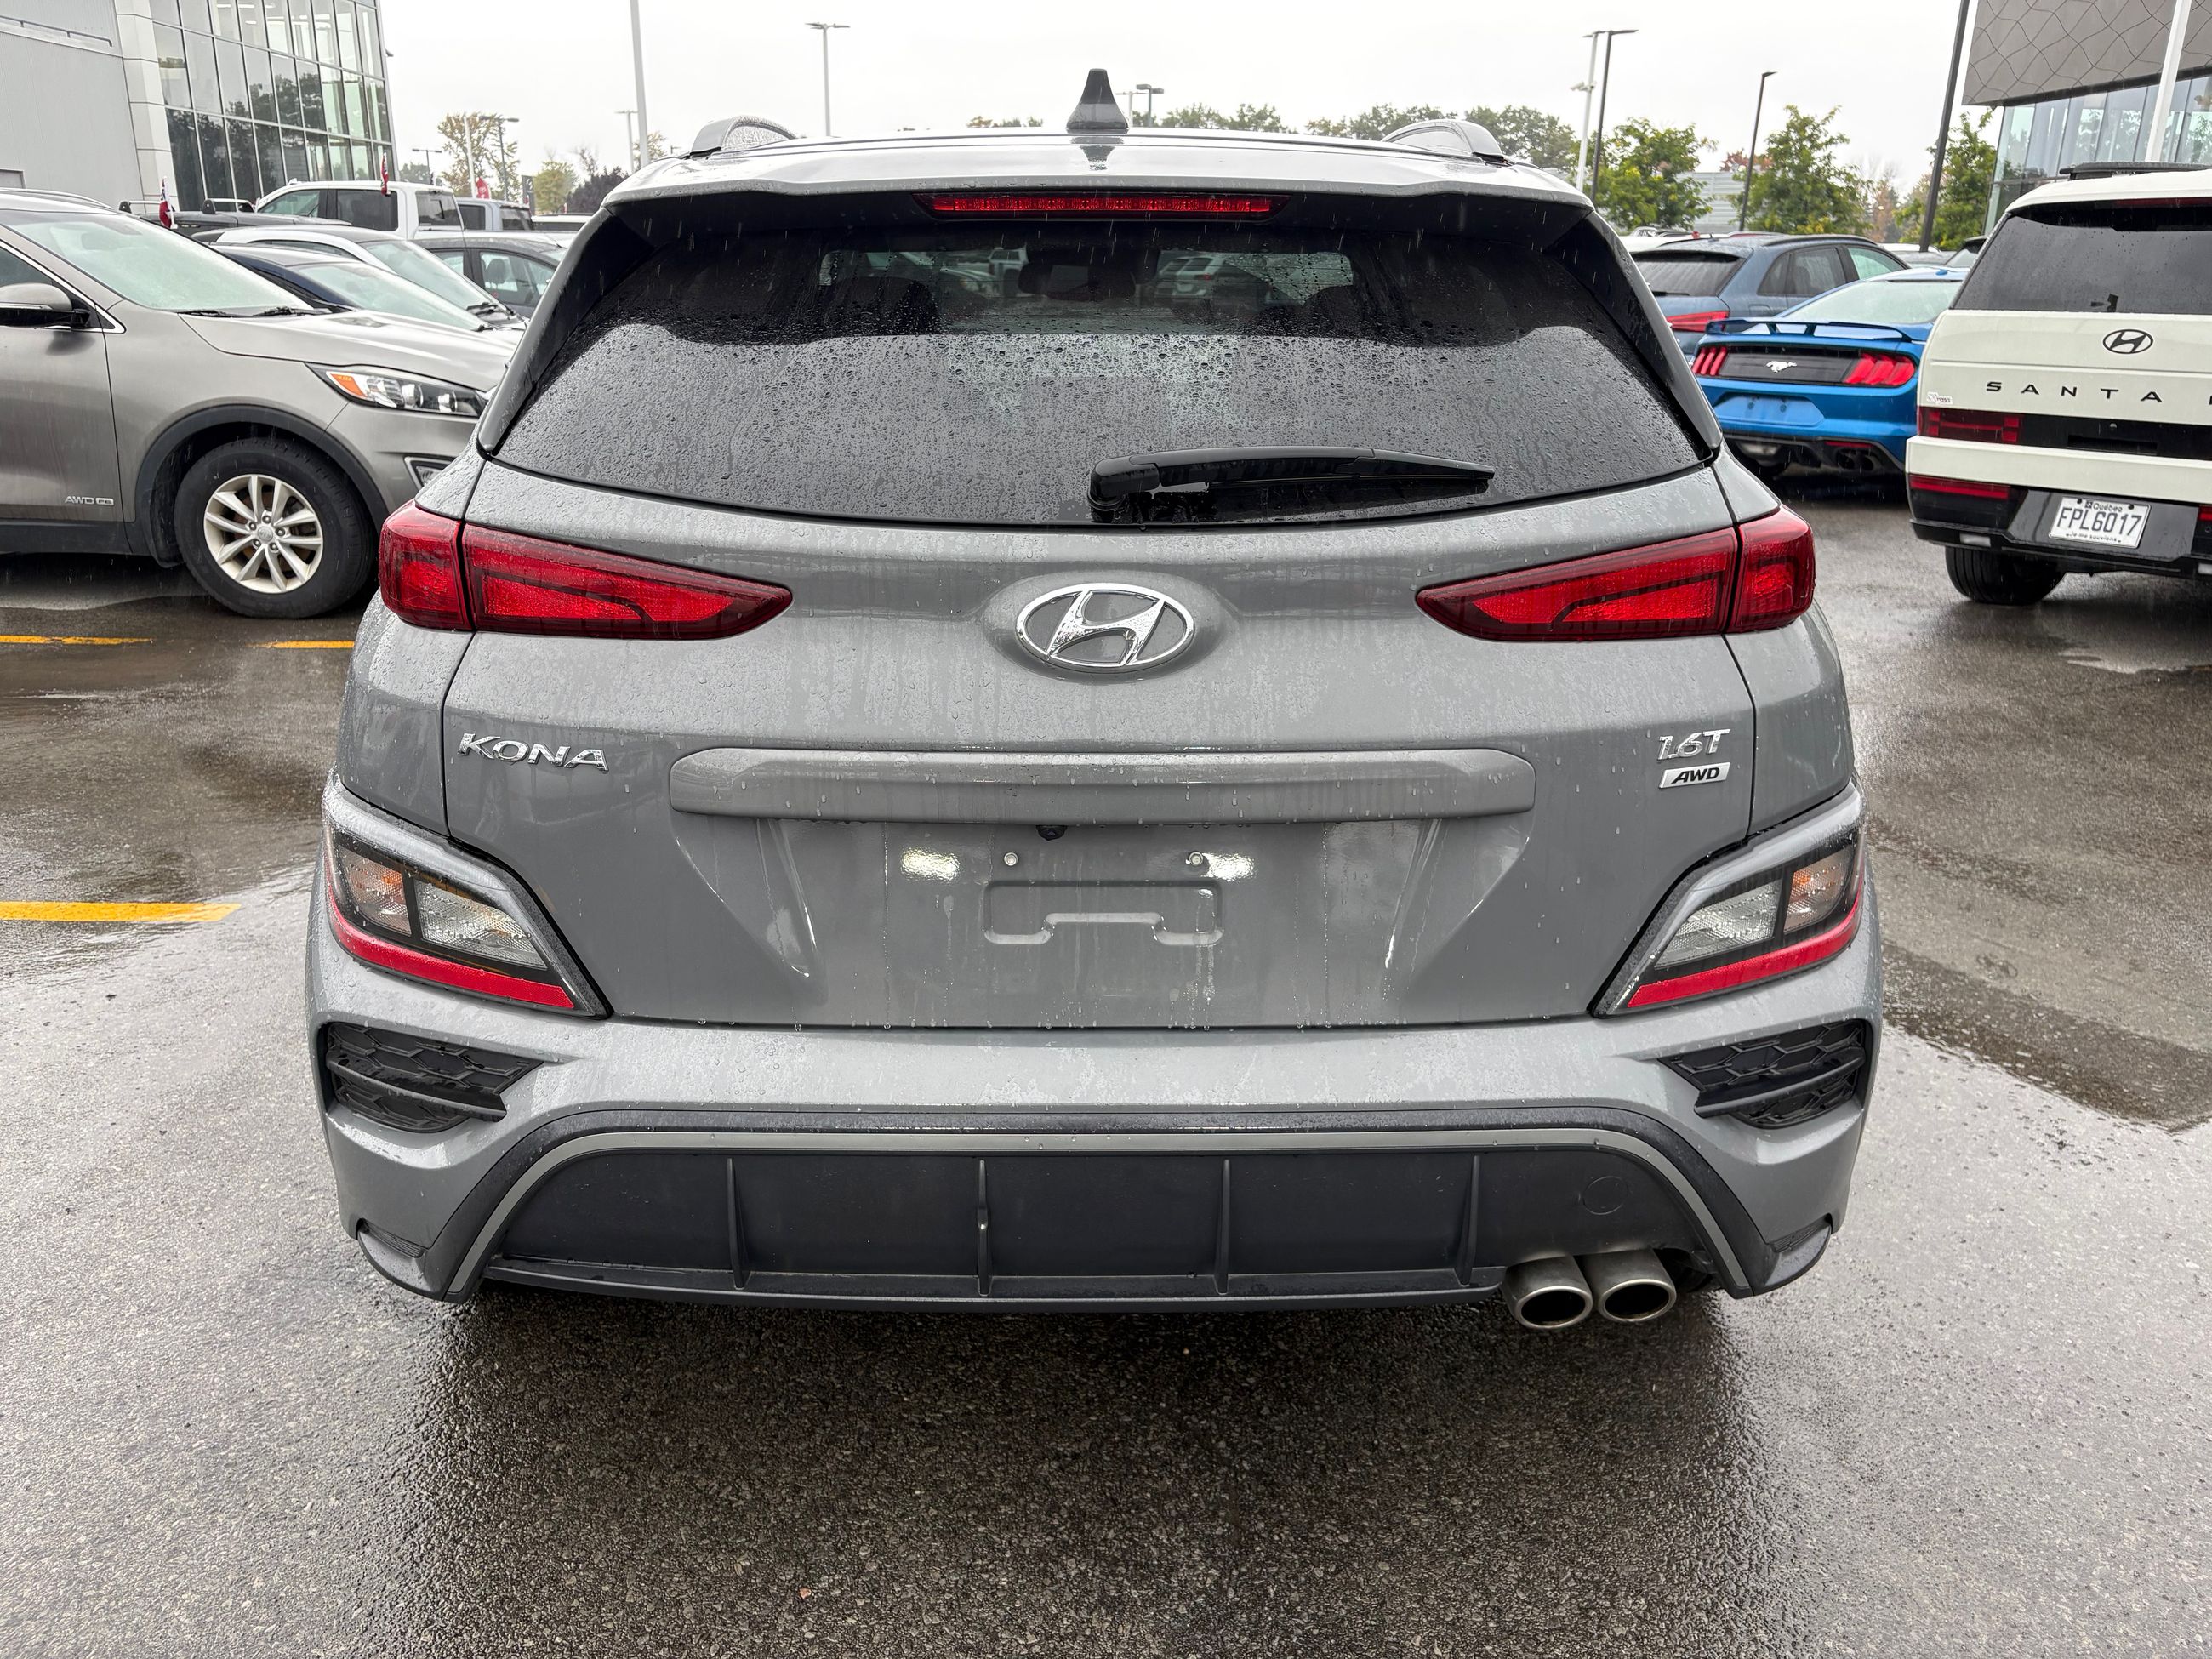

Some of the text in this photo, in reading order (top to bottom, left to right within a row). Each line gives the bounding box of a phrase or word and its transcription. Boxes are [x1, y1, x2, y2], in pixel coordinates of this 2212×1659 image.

[1986, 381, 2163, 403] SANTA
[65, 496, 94, 505] AWD
[2057, 507, 2142, 536] FPL6017
[458, 733, 609, 772] KONA
[1657, 728, 1731, 761] 1.6T
[1671, 767, 1720, 784] AWD
